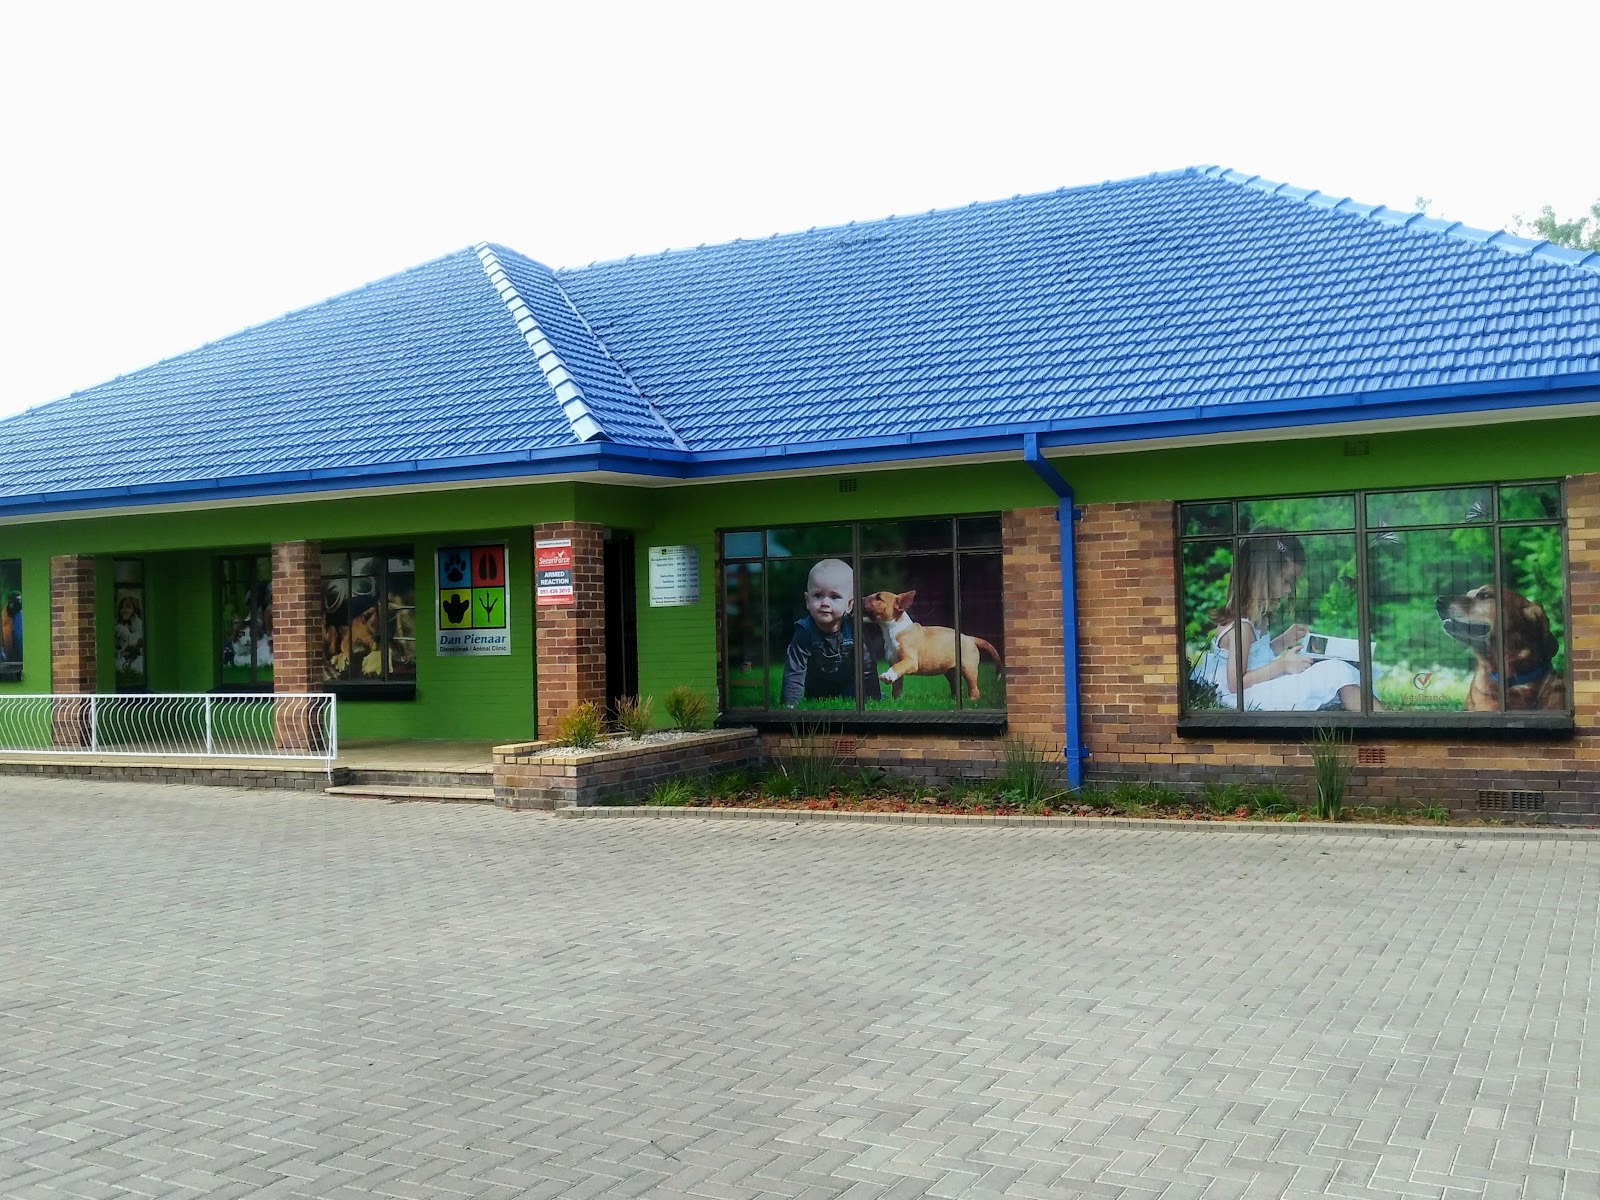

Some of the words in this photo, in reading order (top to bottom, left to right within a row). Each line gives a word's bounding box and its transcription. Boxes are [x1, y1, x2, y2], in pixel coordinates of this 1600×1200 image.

[538, 556, 571, 565] SecuriForce
[440, 635, 461, 645] Dan
[464, 633, 507, 644] Pienaar
[1400, 693, 1450, 702] VetsBrands
